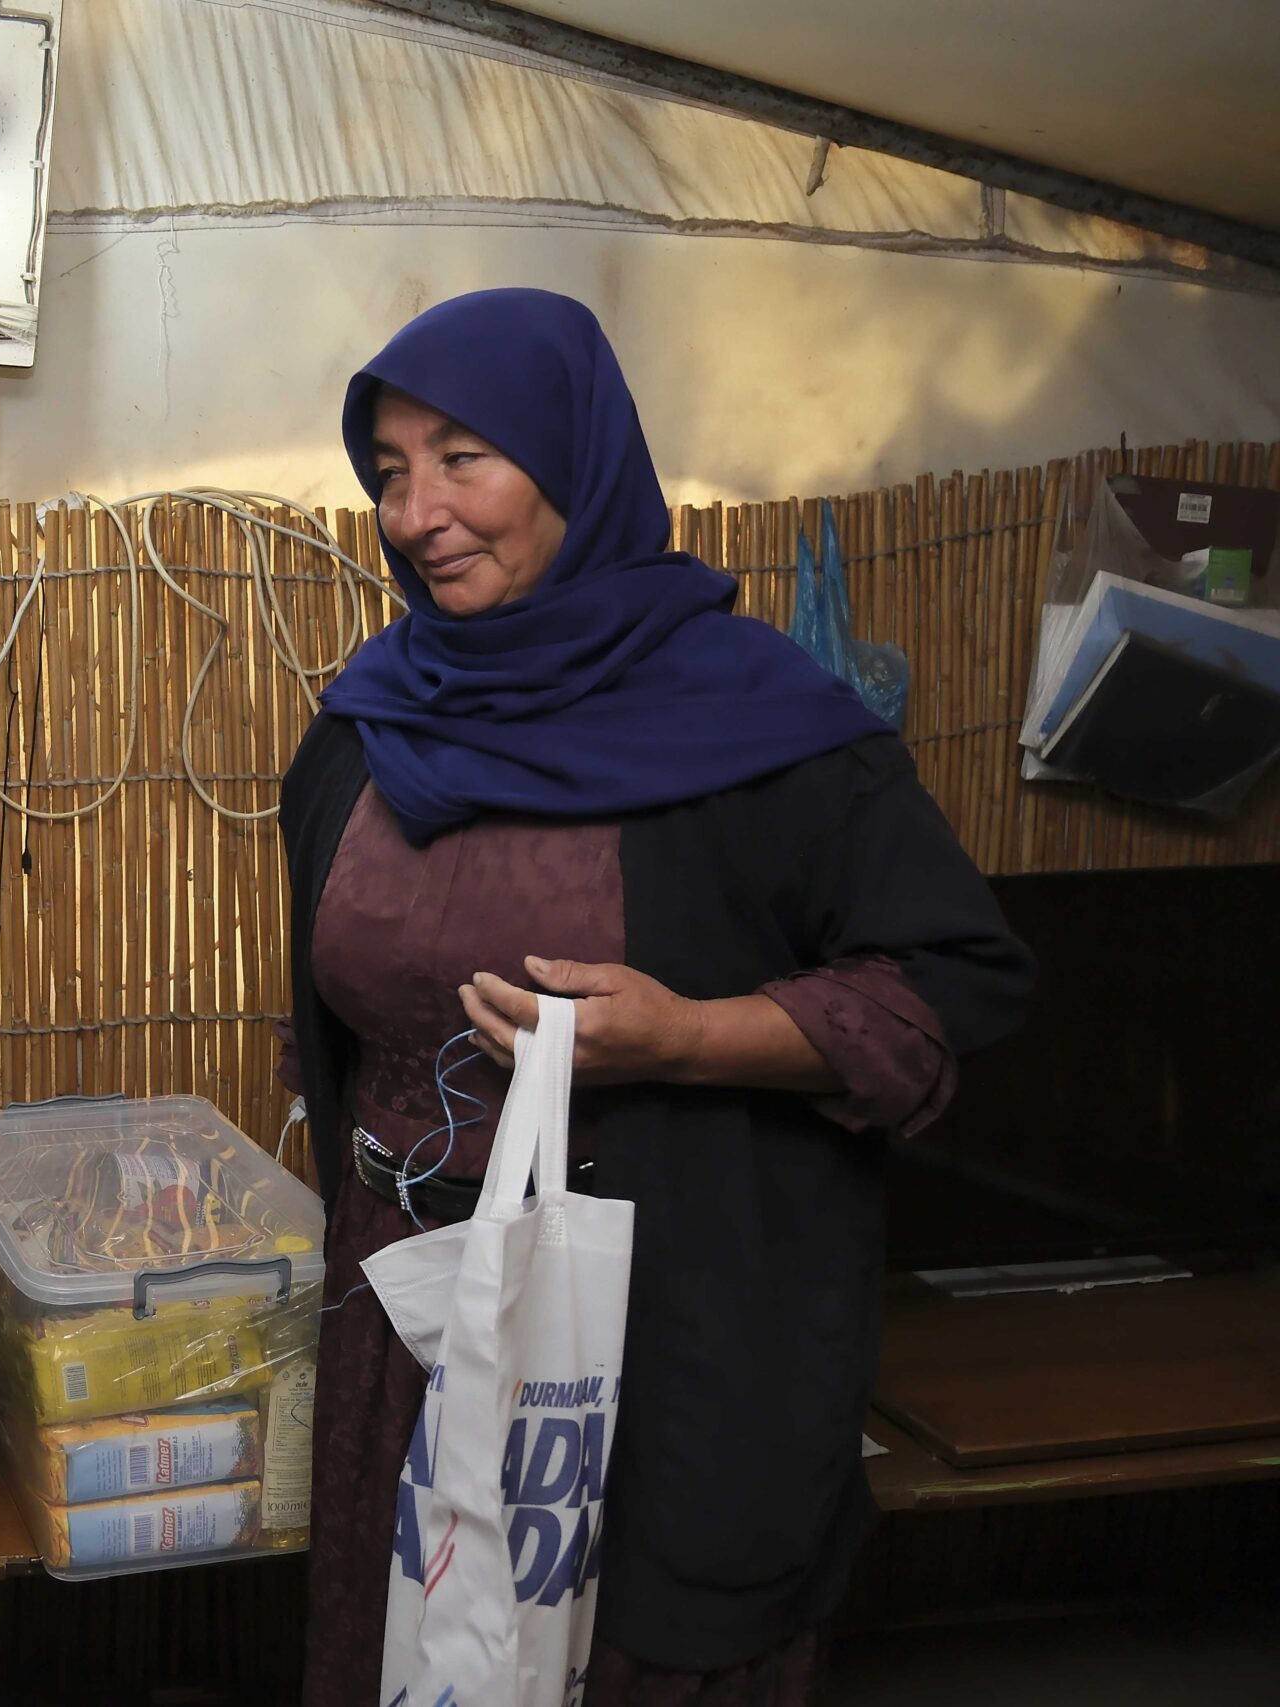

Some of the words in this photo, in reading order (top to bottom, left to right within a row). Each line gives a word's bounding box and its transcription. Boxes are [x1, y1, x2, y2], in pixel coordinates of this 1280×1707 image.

[158, 1439, 171, 1483] Katmer
[501, 1412, 606, 1508] ADA
[162, 1508, 175, 1551] Katmer
